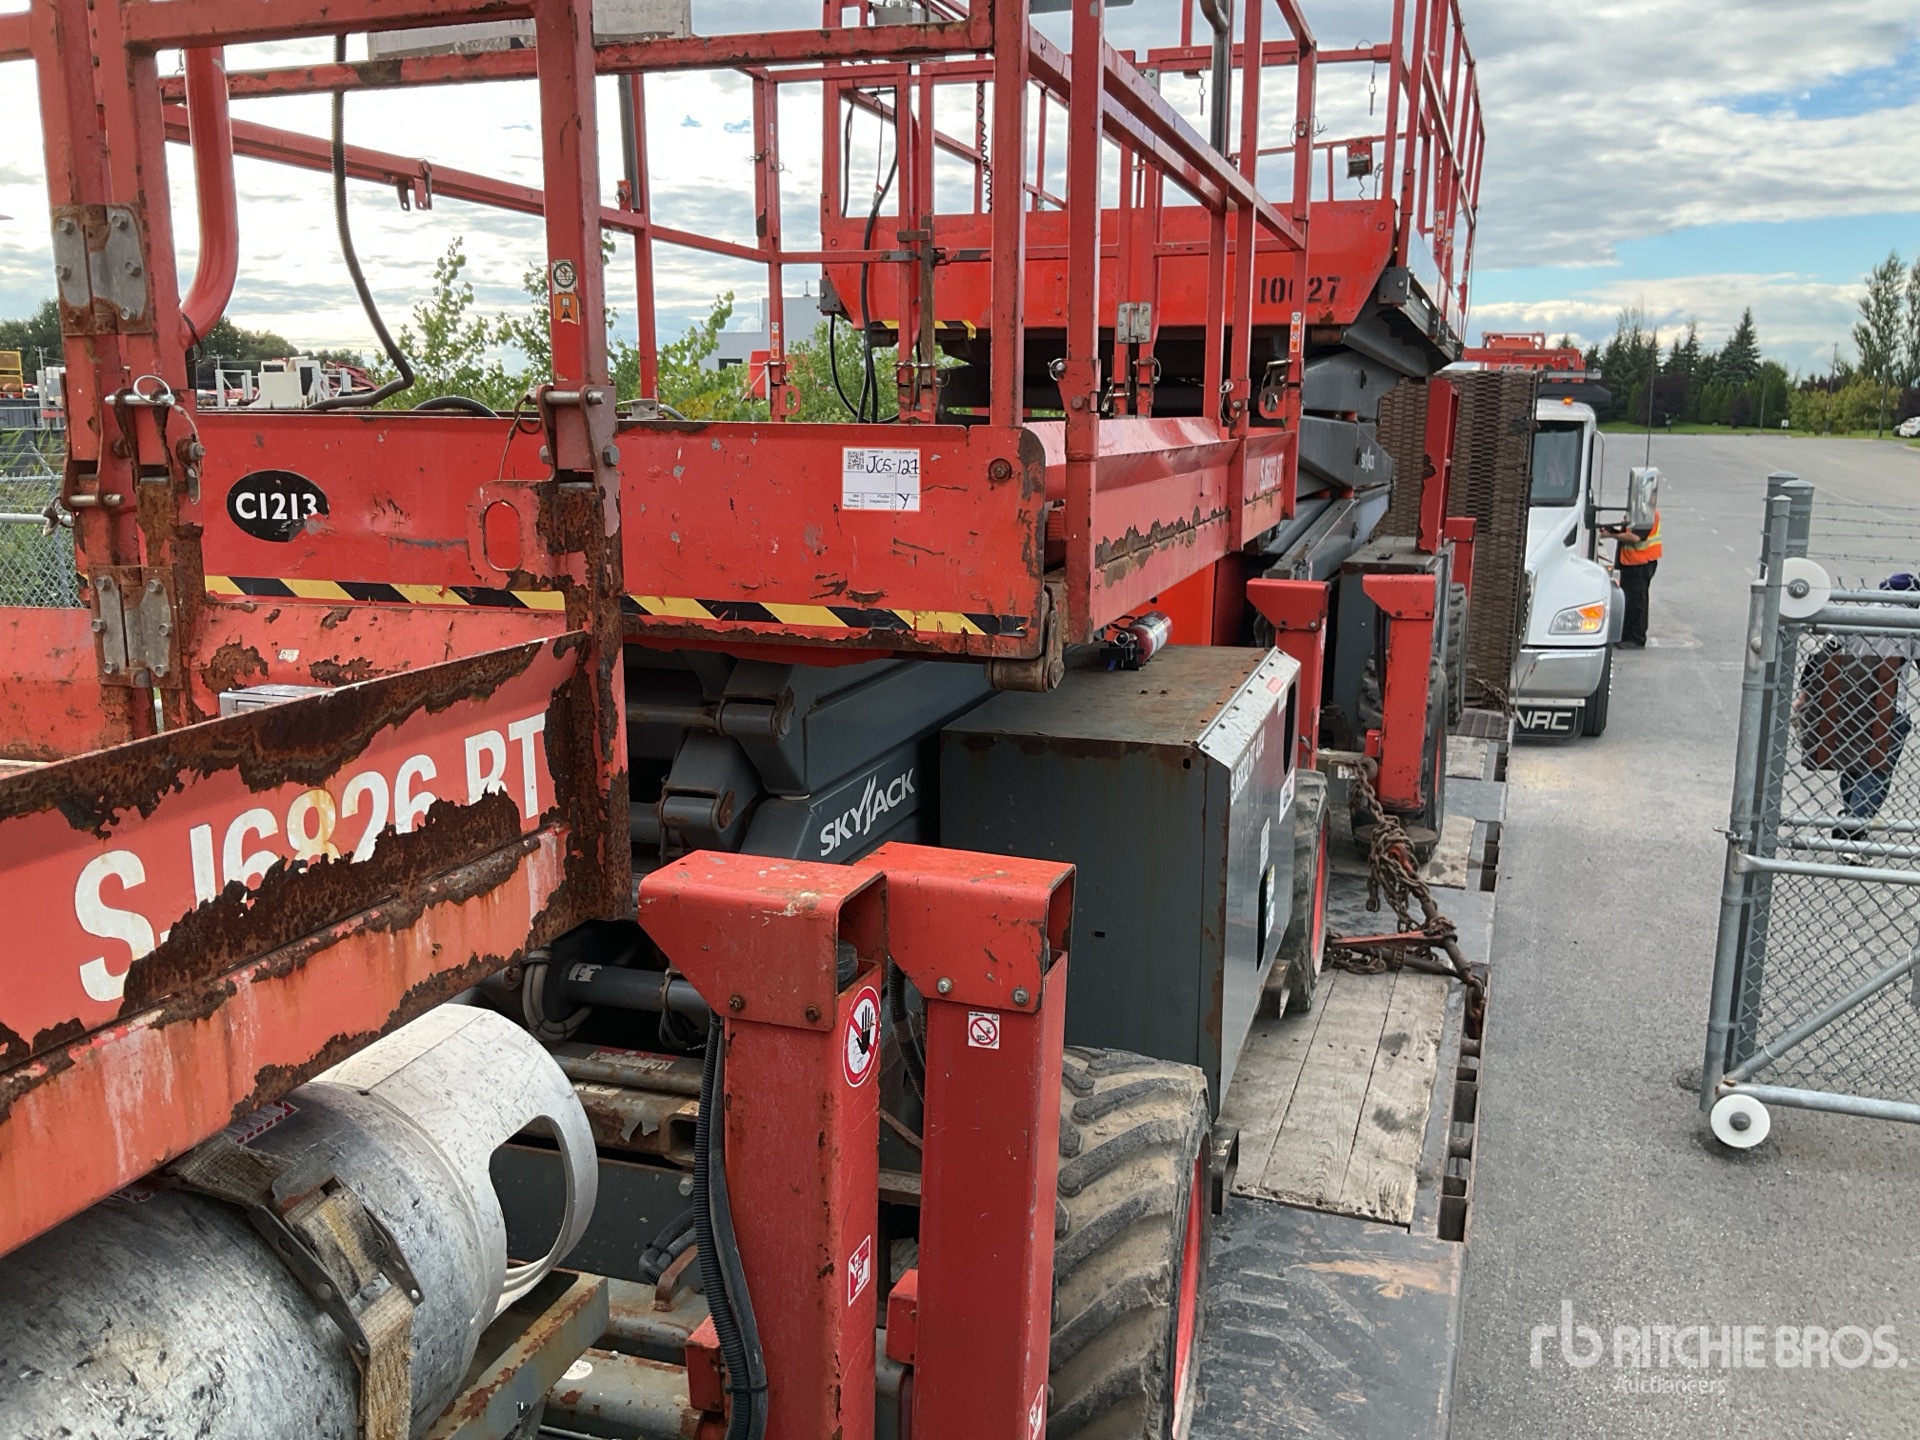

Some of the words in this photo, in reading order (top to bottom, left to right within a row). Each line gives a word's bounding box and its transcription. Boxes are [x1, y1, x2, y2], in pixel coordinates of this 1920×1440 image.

[1260, 276, 1341, 304] 1027
[235, 492, 318, 520] C1213
[464, 712, 546, 820] RT
[820, 767, 916, 857] SKYJACK
